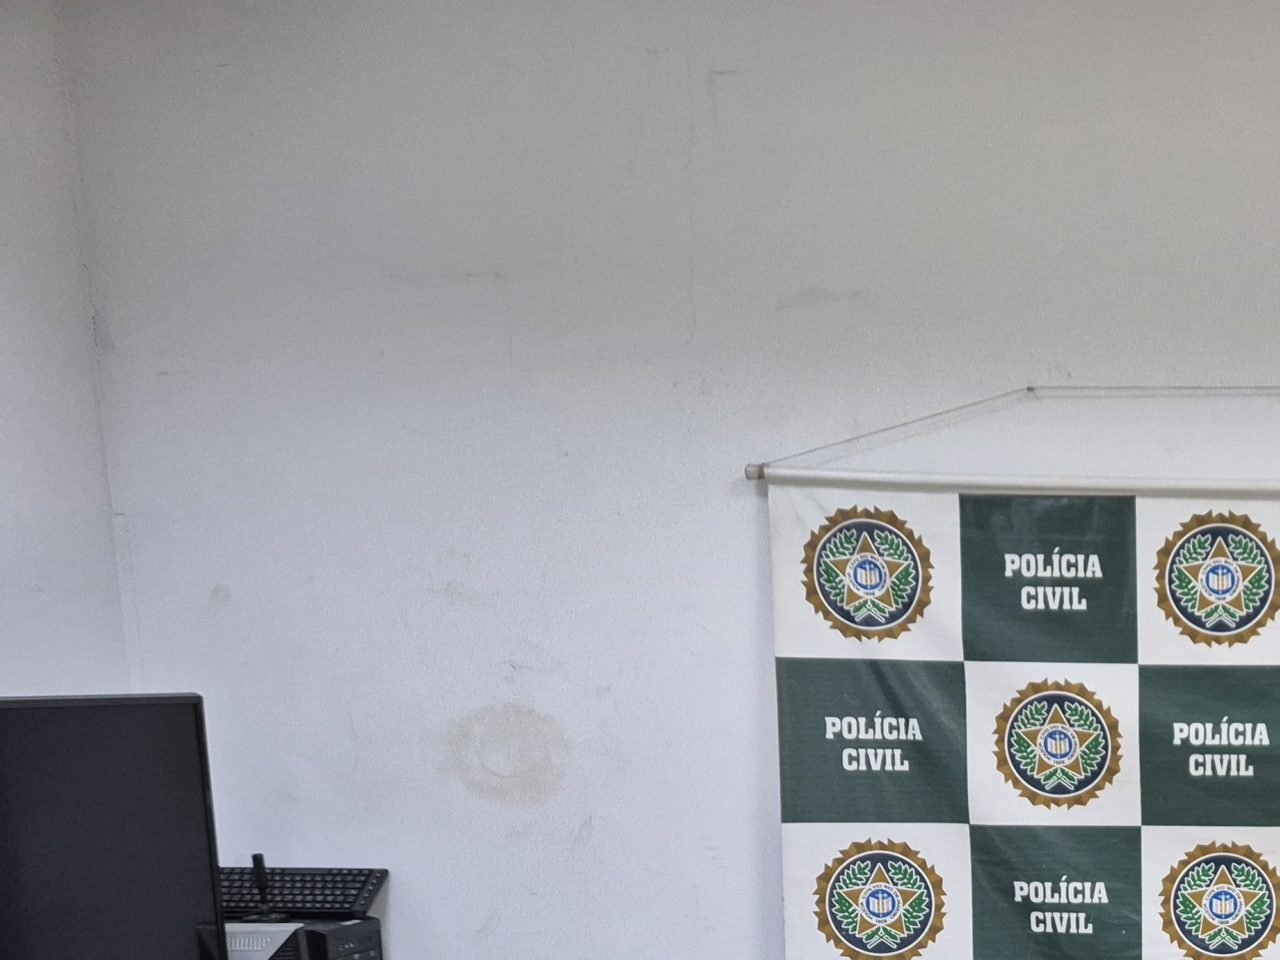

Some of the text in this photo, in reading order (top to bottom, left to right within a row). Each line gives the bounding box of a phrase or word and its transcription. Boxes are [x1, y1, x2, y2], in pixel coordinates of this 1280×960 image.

[1005, 547, 1102, 577] POLÍCIA
[1021, 586, 1087, 610] CIVIL
[825, 711, 922, 740] POLÍCIA
[1173, 716, 1269, 745] POLÍCIA
[843, 748, 909, 771] CIVIL
[1189, 754, 1253, 776] CIVIL
[1014, 875, 1108, 903] POLÍCIA
[1030, 912, 1092, 933] CIVIL
